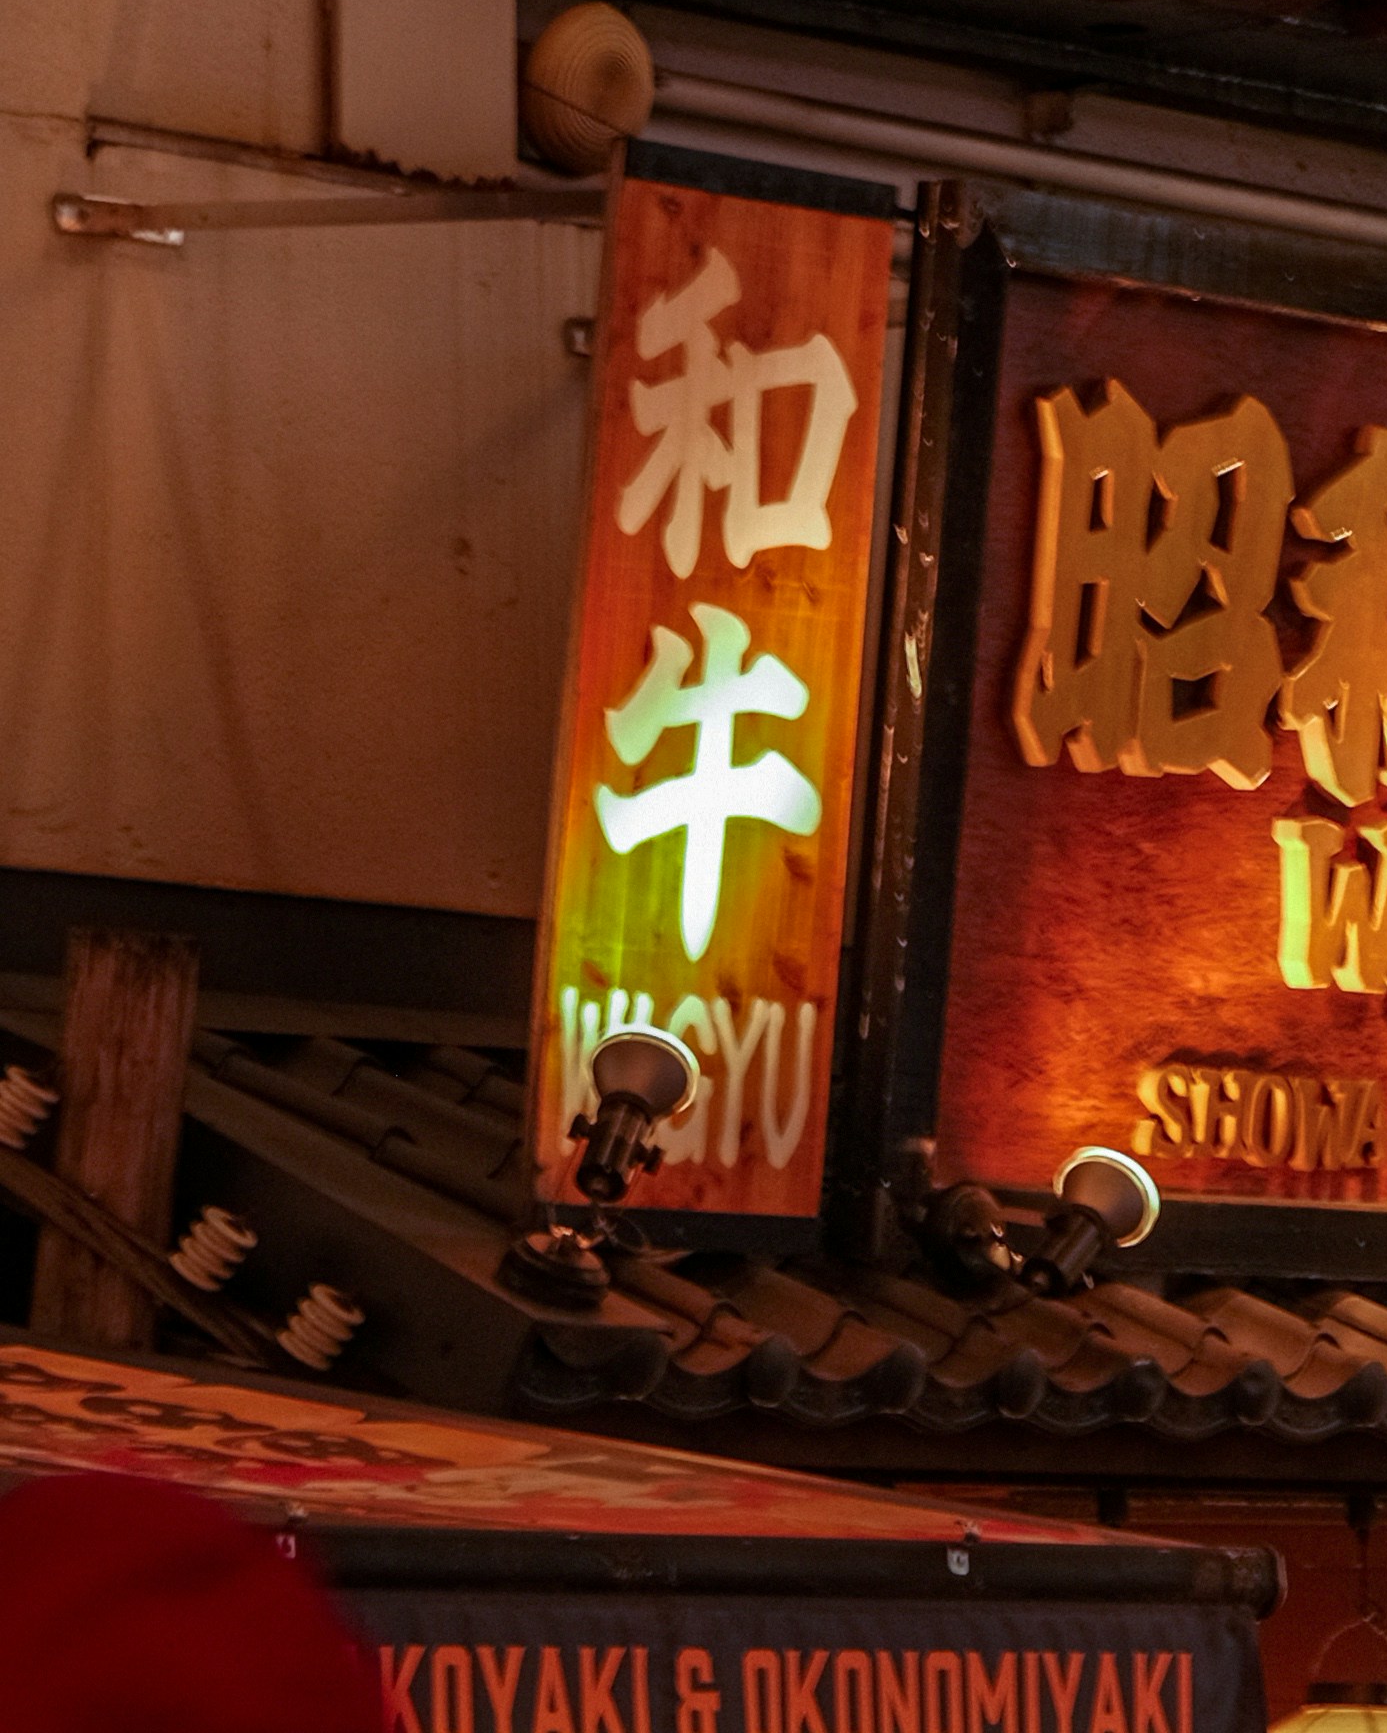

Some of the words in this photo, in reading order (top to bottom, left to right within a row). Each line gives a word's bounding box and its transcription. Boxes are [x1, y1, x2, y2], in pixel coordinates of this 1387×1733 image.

[594, 245, 860, 961] 和牛
[560, 985, 817, 1171] WGYU
[1132, 1063, 1386, 1173] SHOWA
[676, 1648, 722, 1733] &
[742, 1648, 1195, 1733] OKONOMIYAKI
